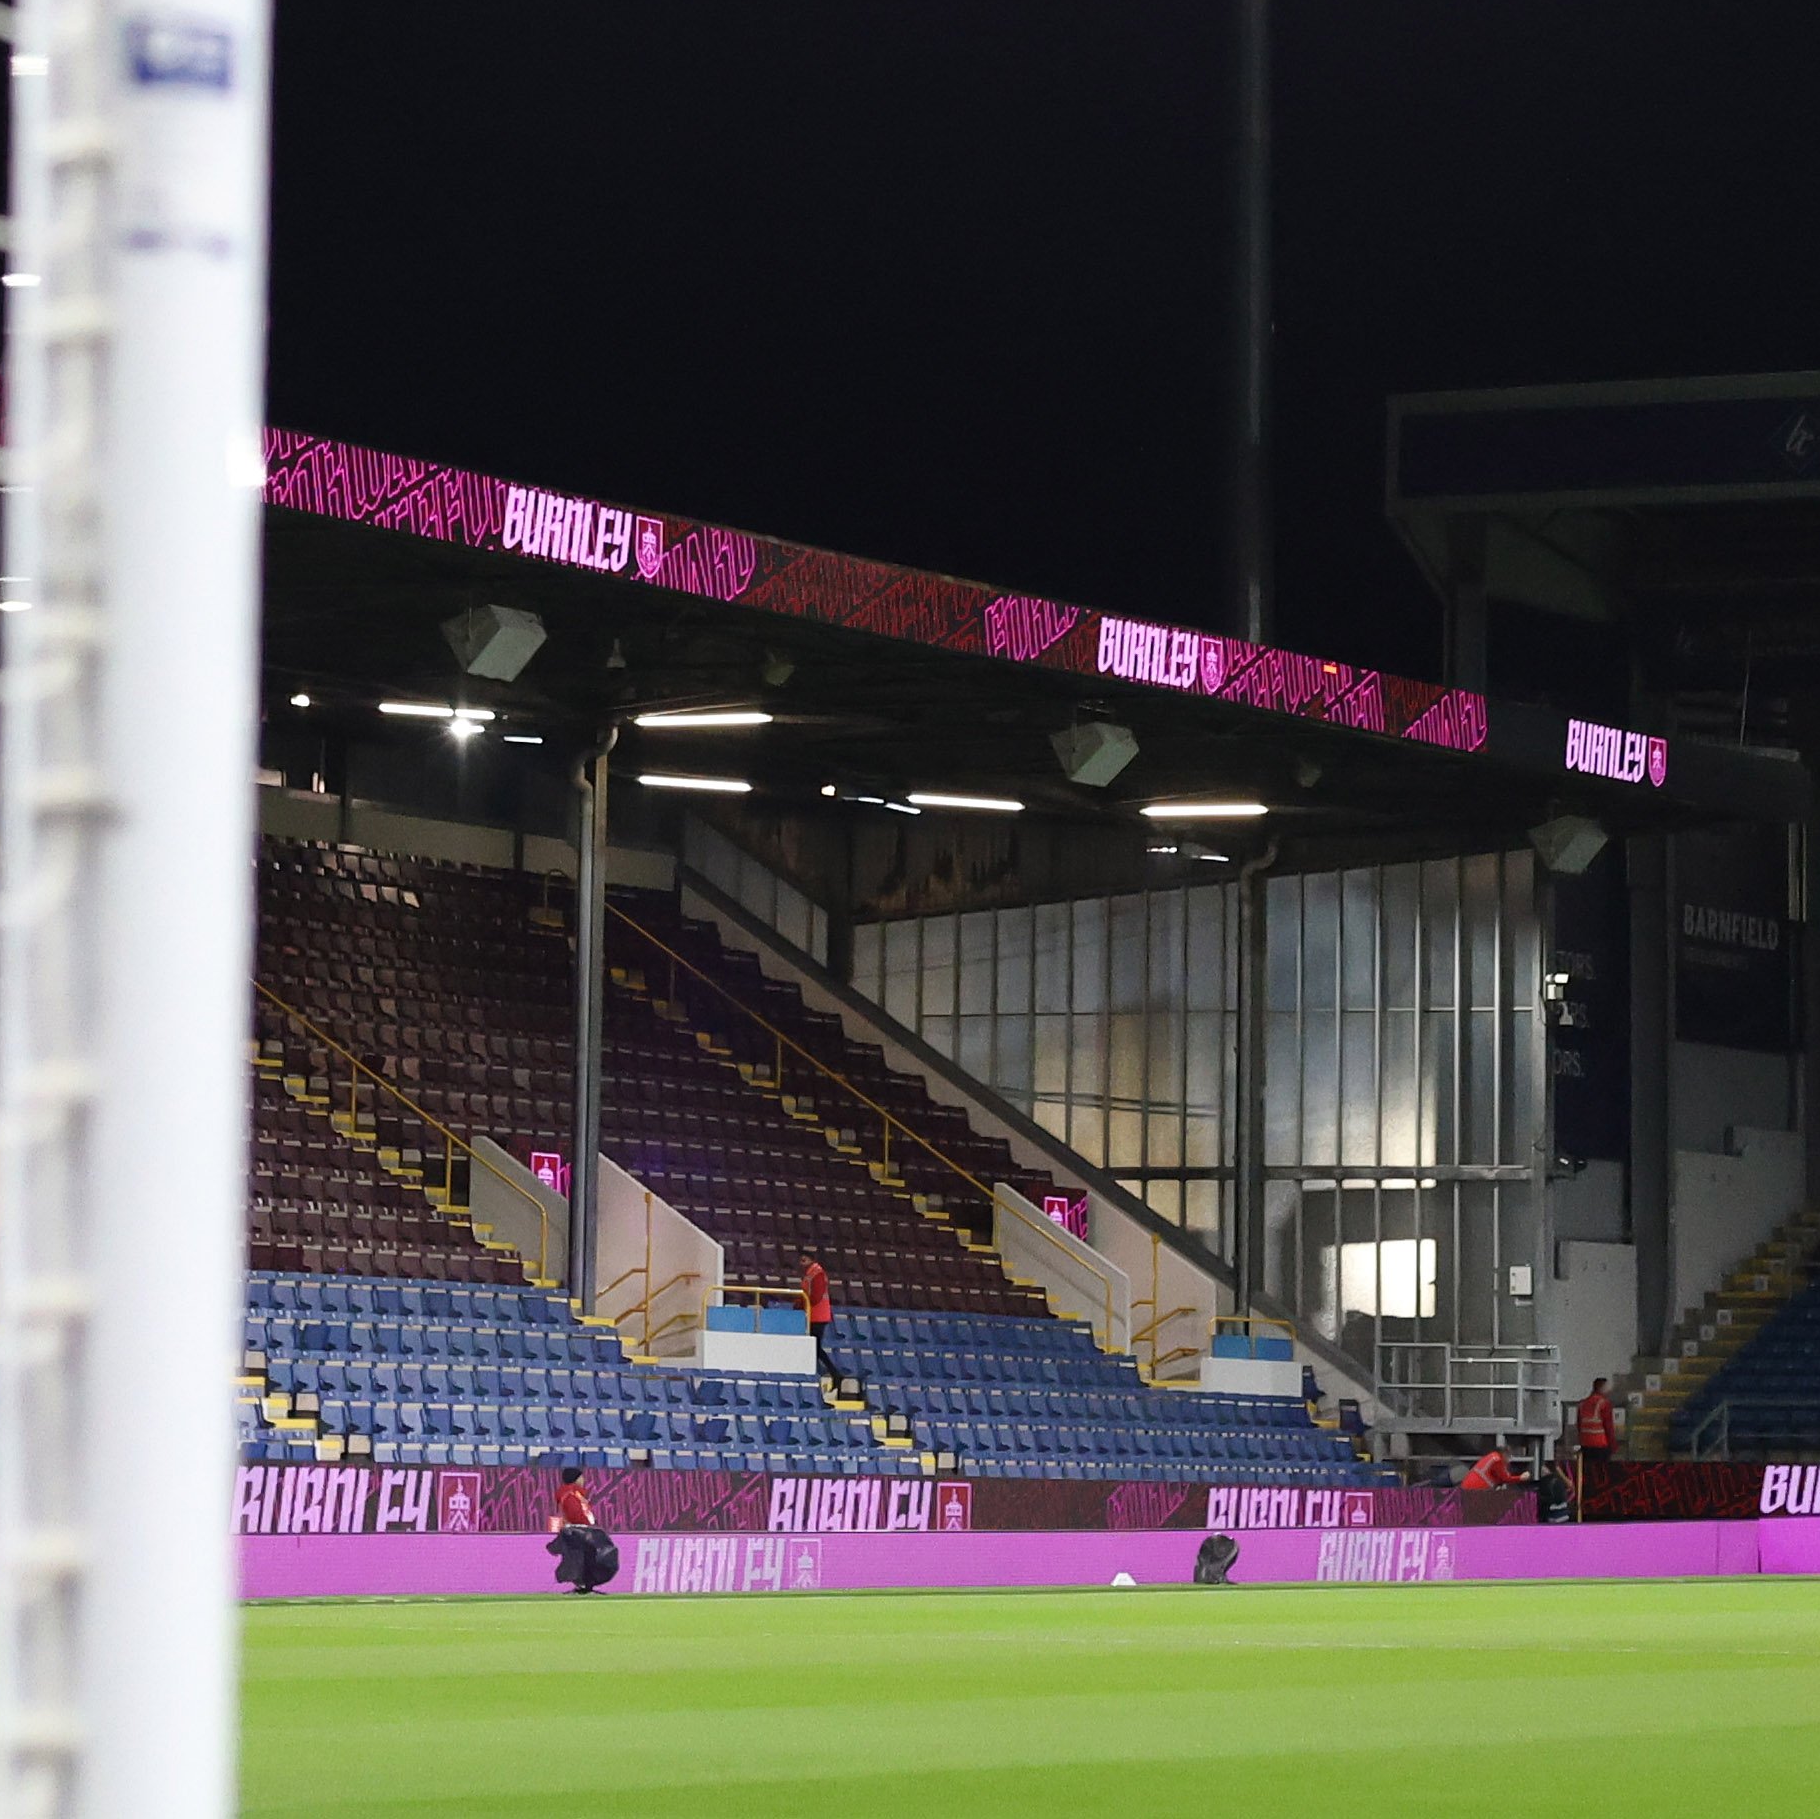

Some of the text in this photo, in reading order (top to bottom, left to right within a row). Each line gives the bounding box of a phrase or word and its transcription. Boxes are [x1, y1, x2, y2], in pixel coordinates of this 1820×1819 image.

[503, 485, 632, 573] BURNLEY
[1097, 616, 1199, 689] BURNLEY
[1566, 718, 1647, 784] BURNLEY
[1683, 904, 1779, 952] BARNFIELD
[234, 1465, 433, 1533] BURNLEY
